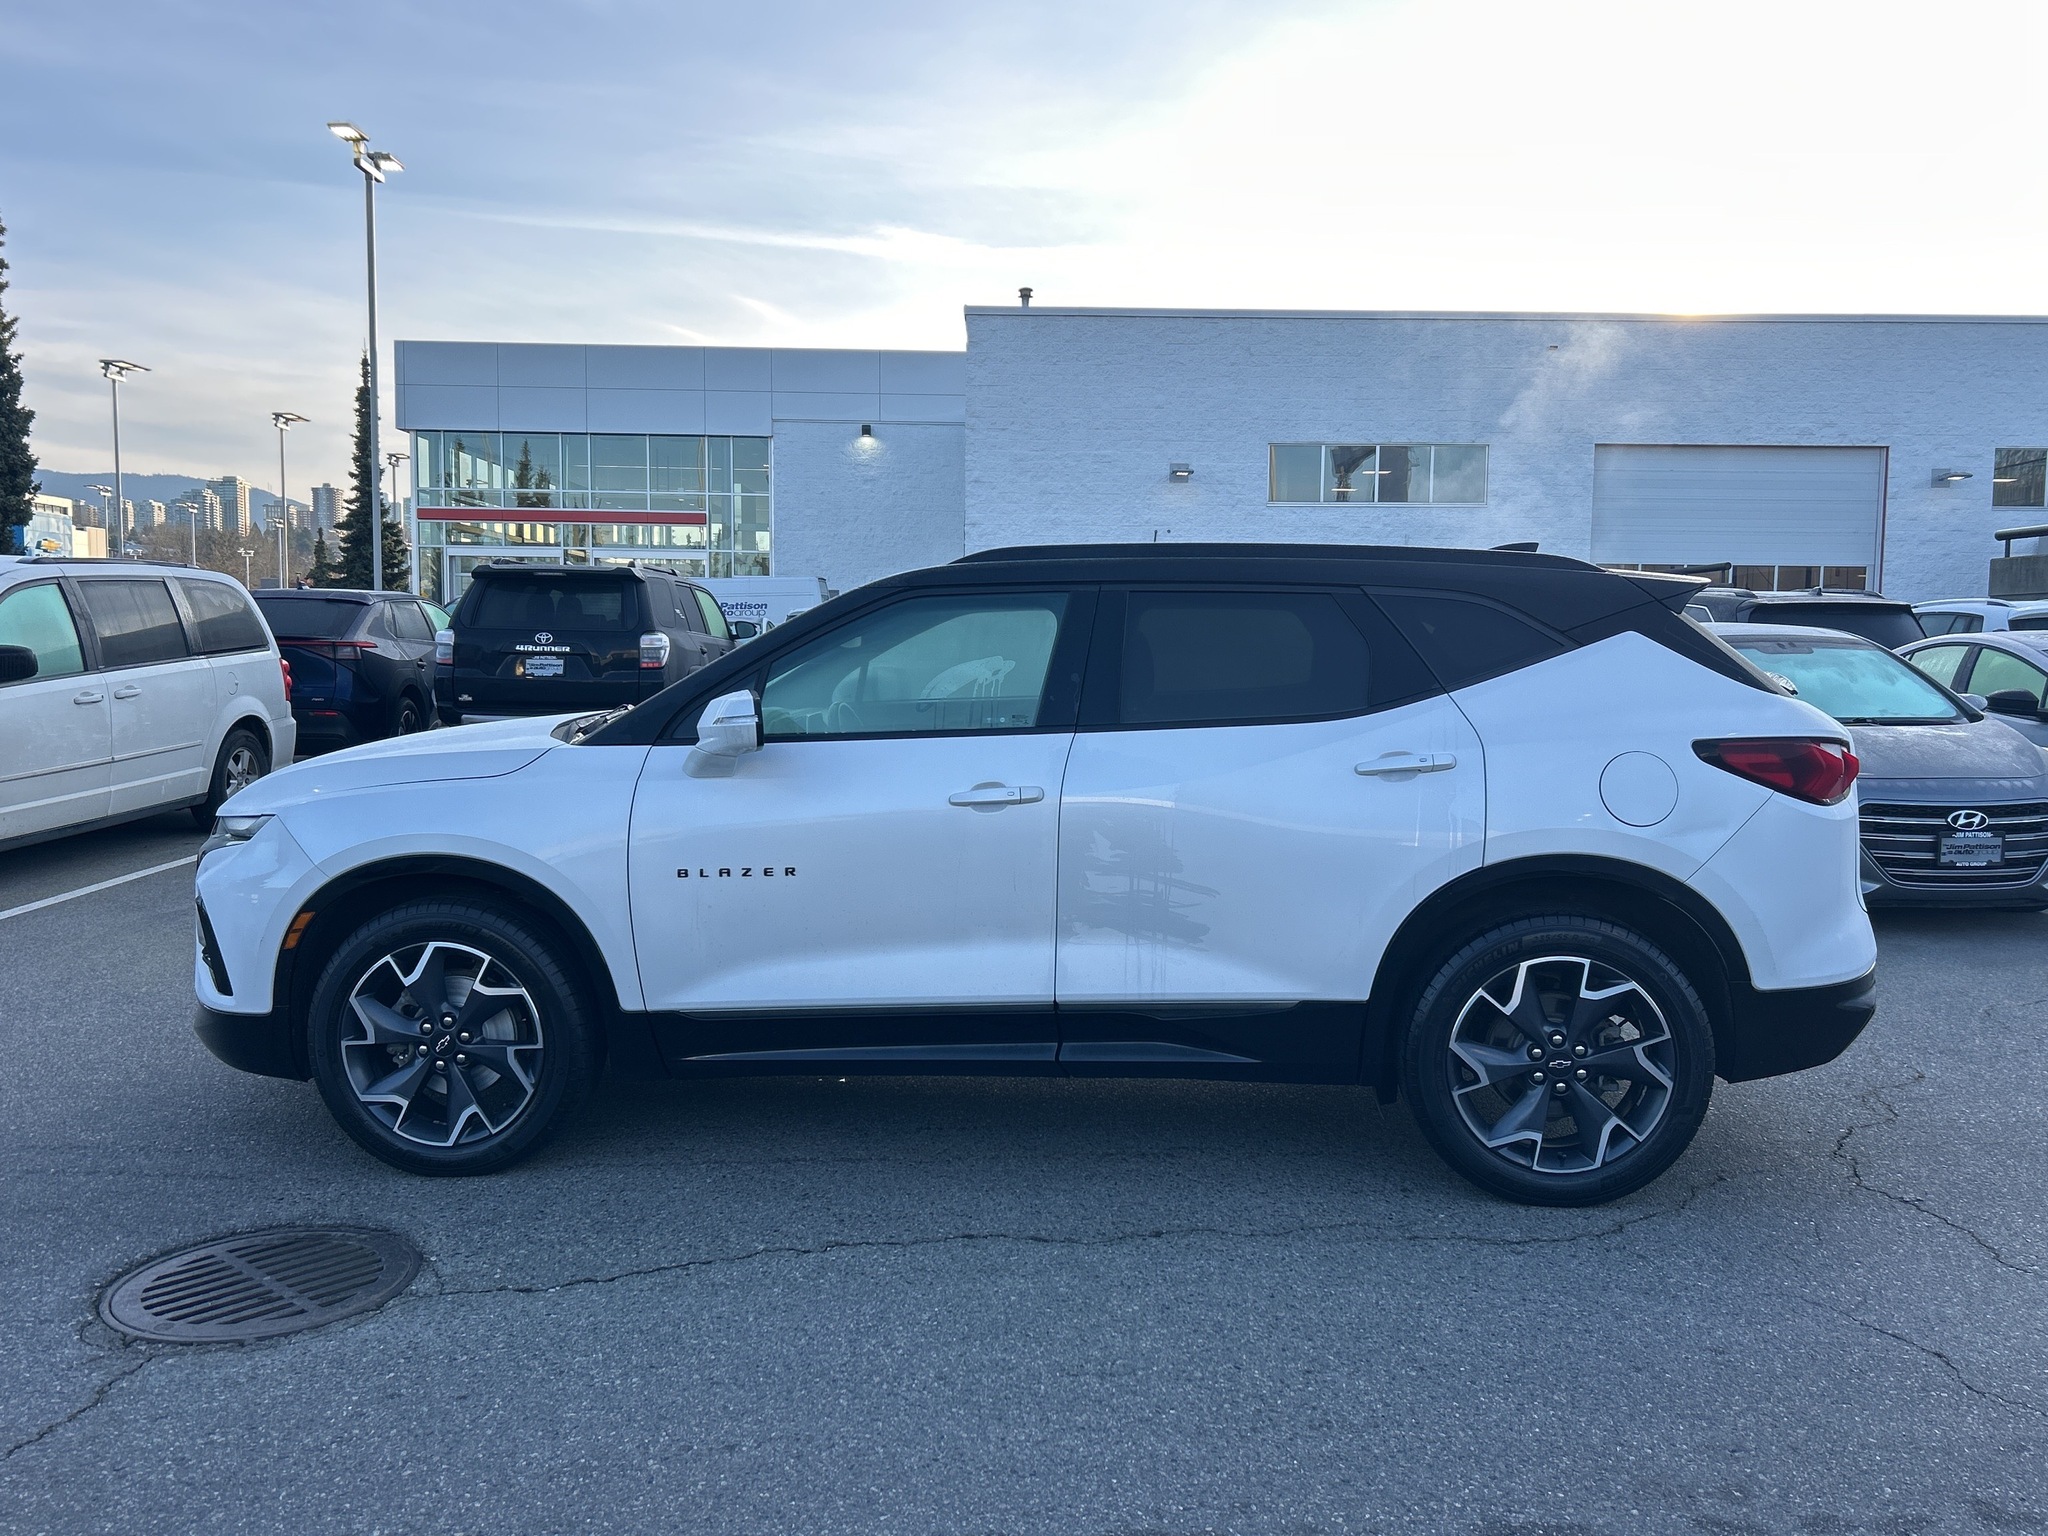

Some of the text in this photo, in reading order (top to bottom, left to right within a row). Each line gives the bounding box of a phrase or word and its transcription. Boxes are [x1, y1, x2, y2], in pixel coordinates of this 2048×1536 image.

[720, 602, 768, 610] Pattison
[723, 609, 766, 617] togroup
[677, 867, 796, 878] BLAZER
